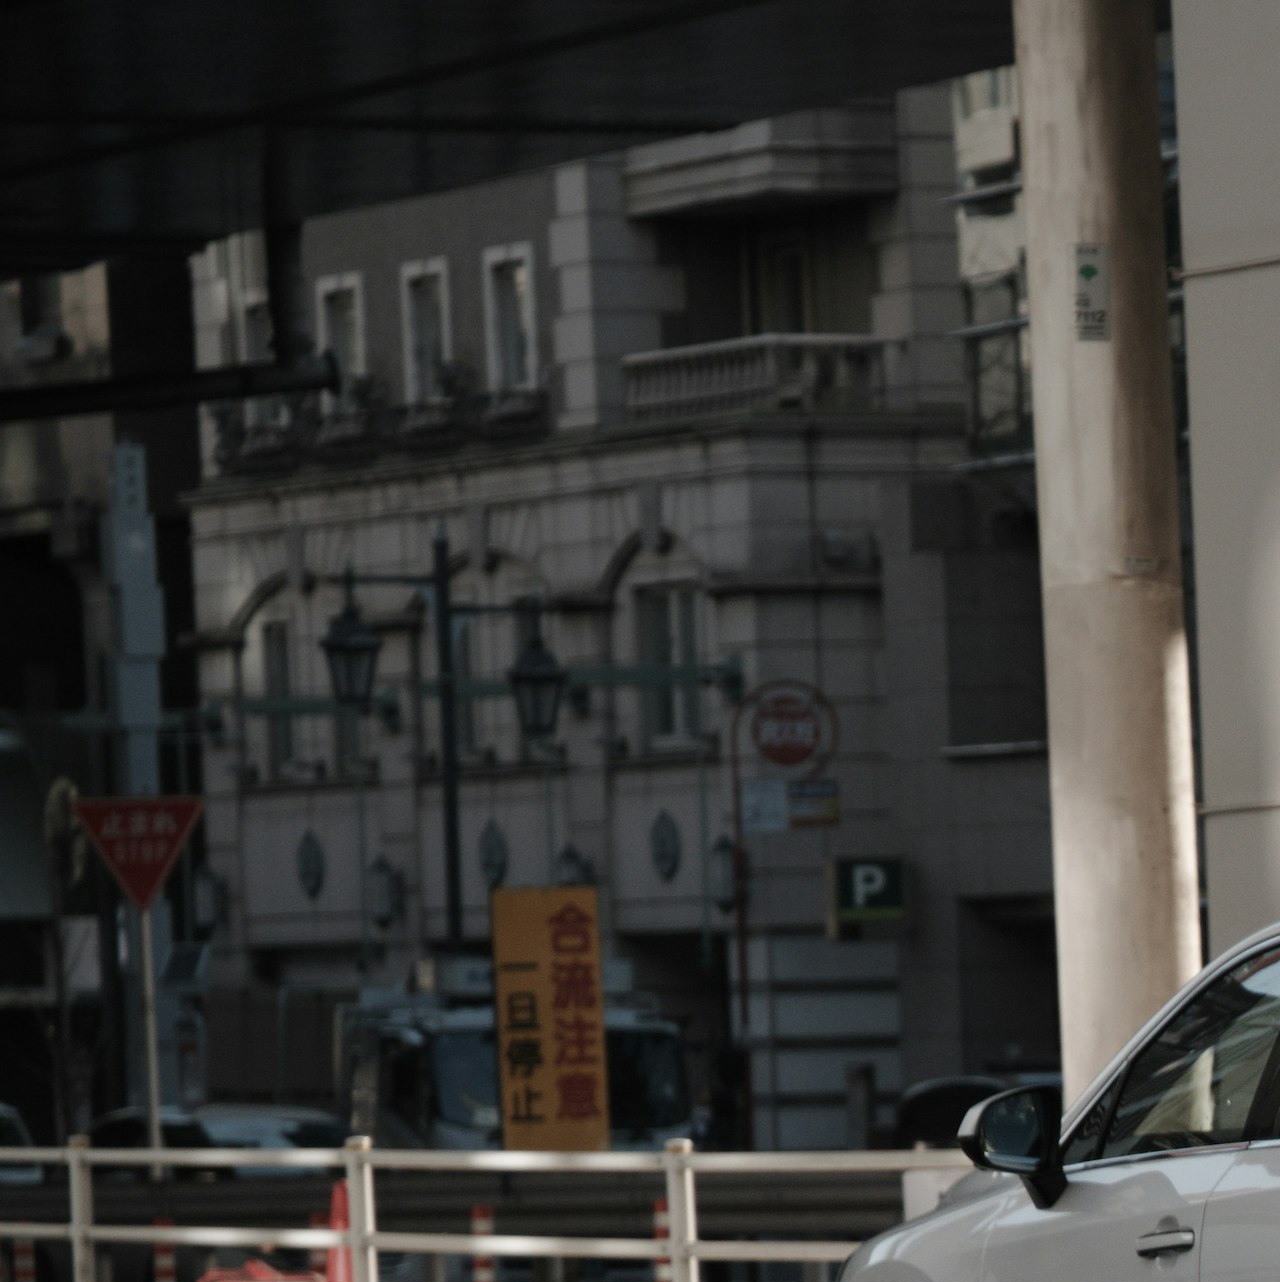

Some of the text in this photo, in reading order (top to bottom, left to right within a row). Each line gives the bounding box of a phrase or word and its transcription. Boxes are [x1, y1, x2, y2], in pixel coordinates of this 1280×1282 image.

[101, 809, 177, 838] 止まれ
[111, 838, 168, 864] STOP
[852, 863, 887, 905] P
[547, 903, 601, 1121] 合流注意
[502, 960, 545, 1125] 一旦停止
